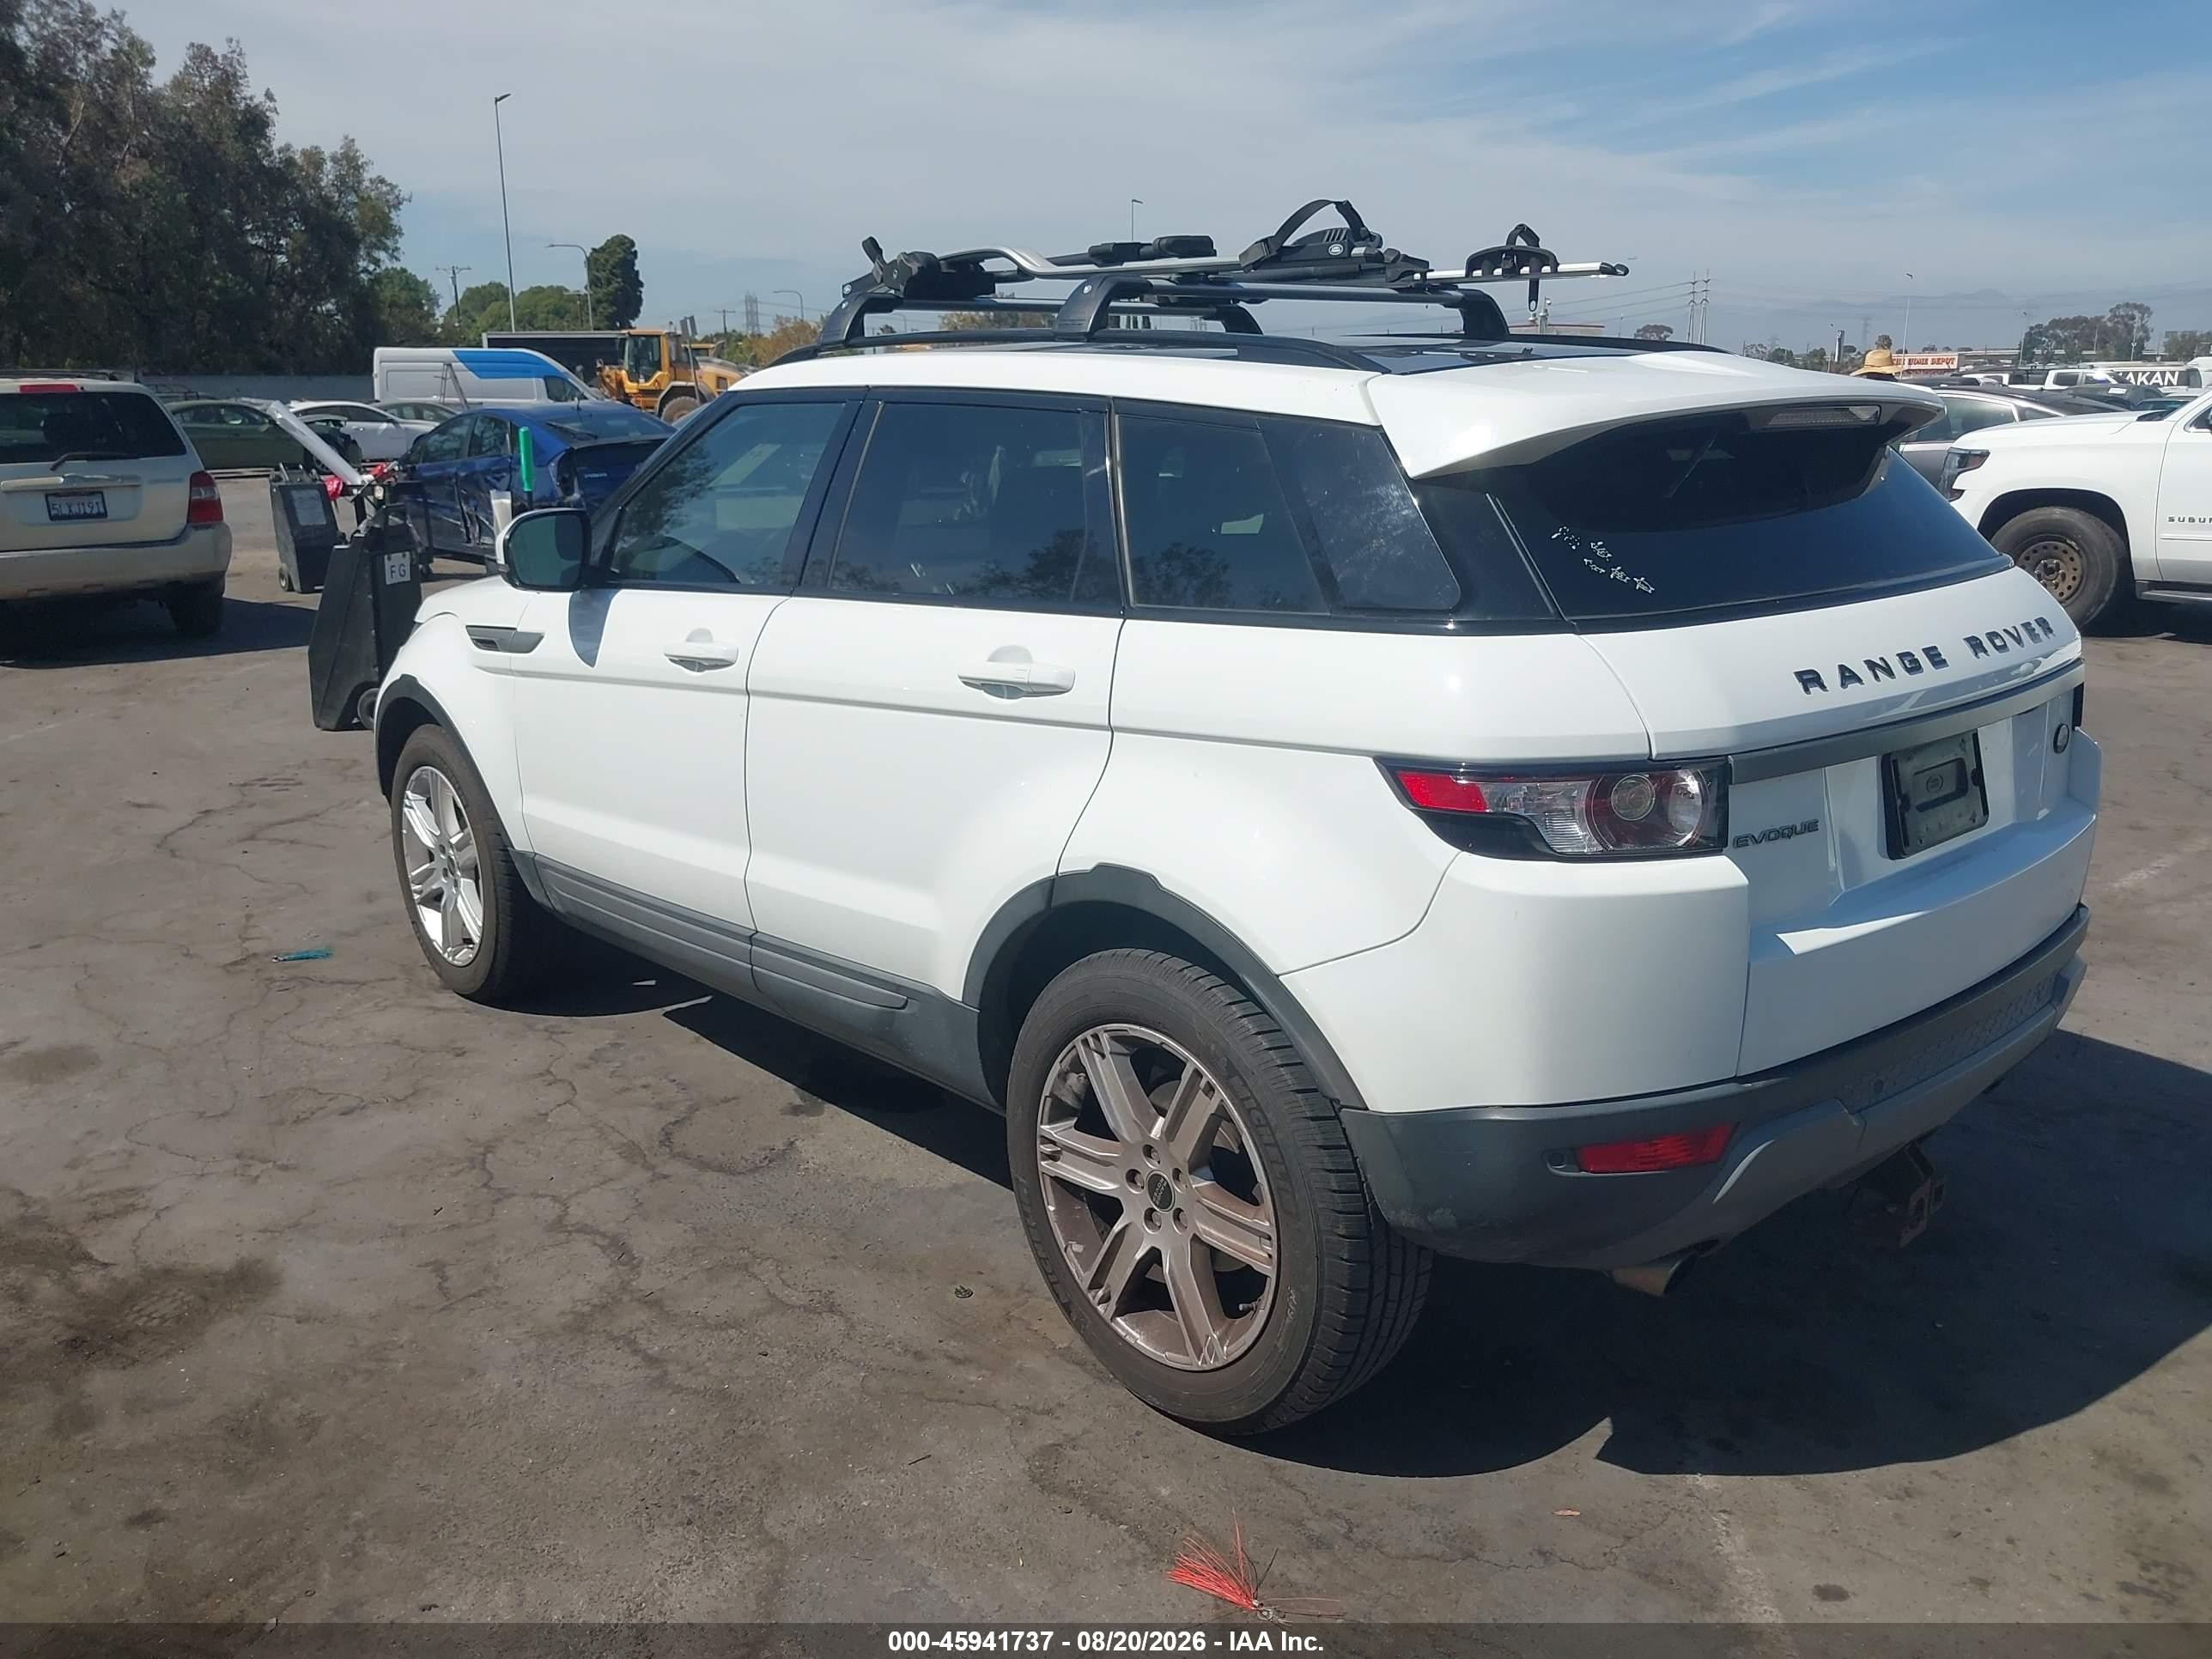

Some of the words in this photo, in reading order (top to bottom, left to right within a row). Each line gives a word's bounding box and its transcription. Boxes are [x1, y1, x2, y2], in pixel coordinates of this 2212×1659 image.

[1930, 357, 1956, 366] DEPOT
[1793, 645, 1950, 696] RANGE
[1963, 617, 2057, 659] ROVER
[1733, 818, 1820, 848] EVOQUE
